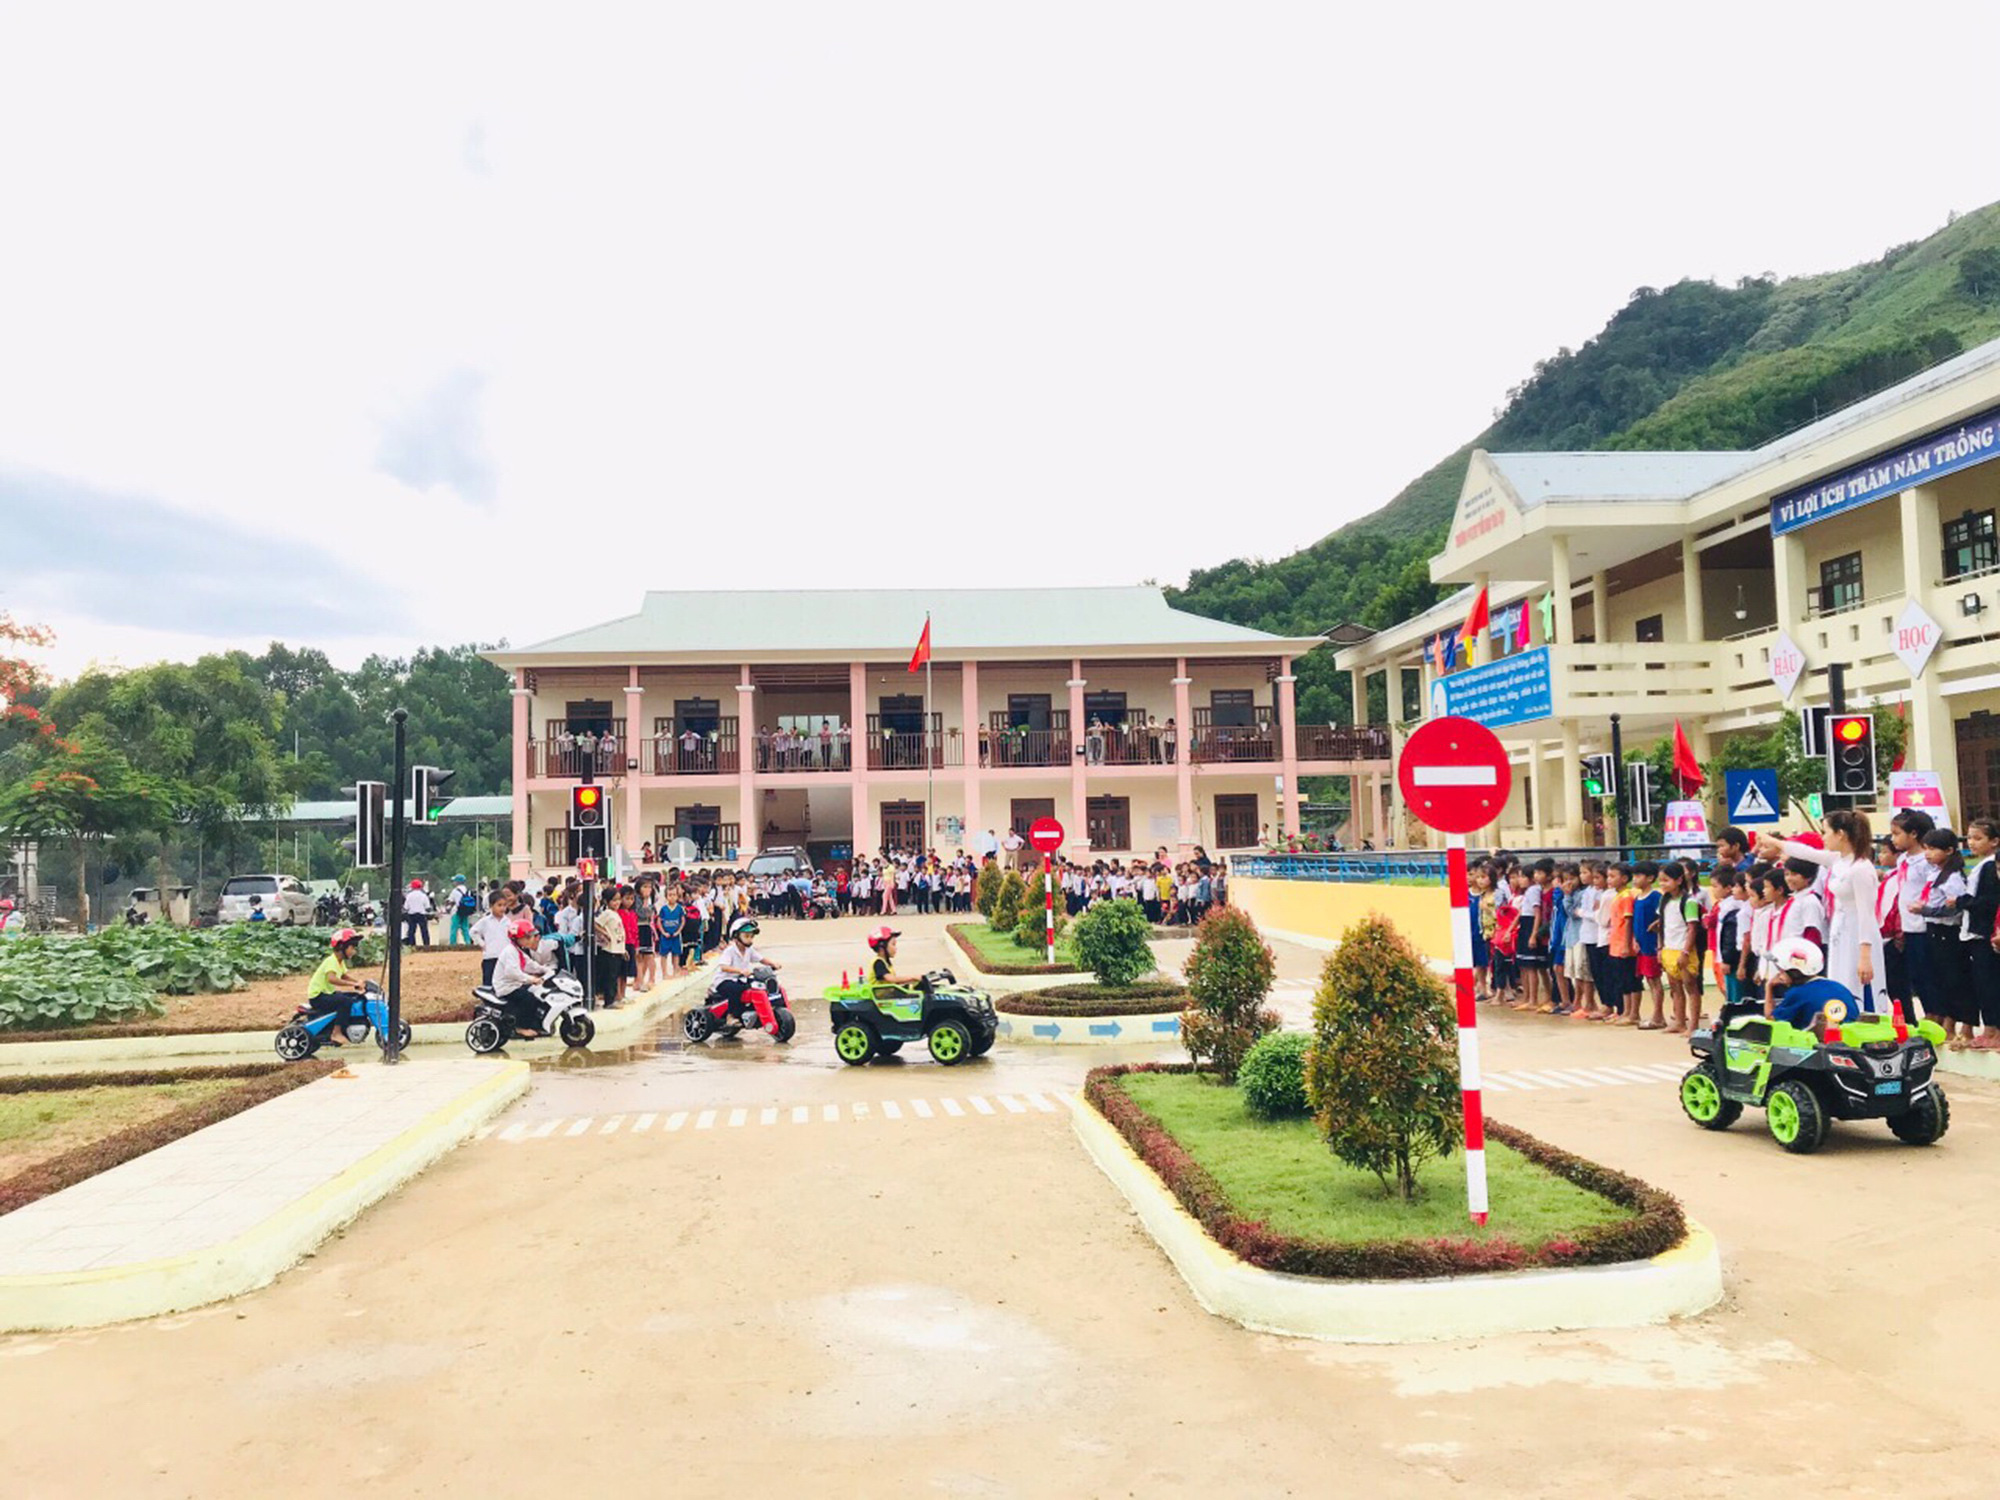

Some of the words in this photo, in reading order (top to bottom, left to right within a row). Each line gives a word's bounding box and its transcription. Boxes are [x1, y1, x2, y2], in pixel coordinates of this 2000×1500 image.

[1781, 500, 1795, 522] VÌ
[1797, 493, 1819, 518] LỢI
[1821, 486, 1846, 508] ÍCH
[1848, 467, 1891, 497] TRĂM
[1894, 451, 1931, 480] NĂM
[1933, 427, 1994, 465] TRỒNG
[1898, 624, 1932, 654] HỌC
